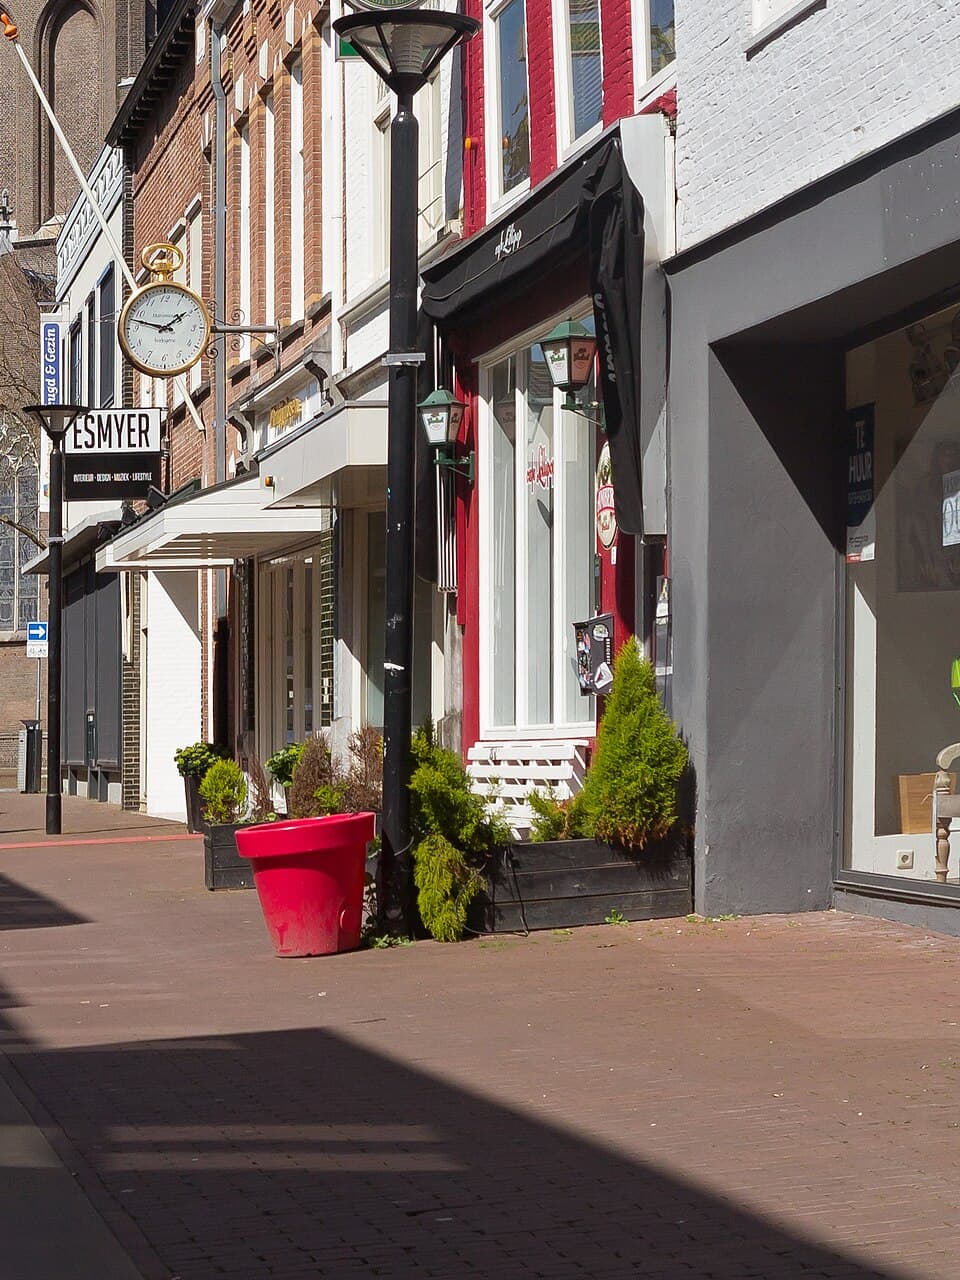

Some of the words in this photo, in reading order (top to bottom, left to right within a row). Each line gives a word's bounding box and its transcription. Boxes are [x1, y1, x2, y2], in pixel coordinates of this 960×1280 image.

[45, 328, 56, 362] Gezin
[45, 365, 56, 375] &
[73, 413, 150, 450] ESMYER
[132, 472, 152, 481] LIFESTYLE
[848, 451, 872, 483] HUUR
